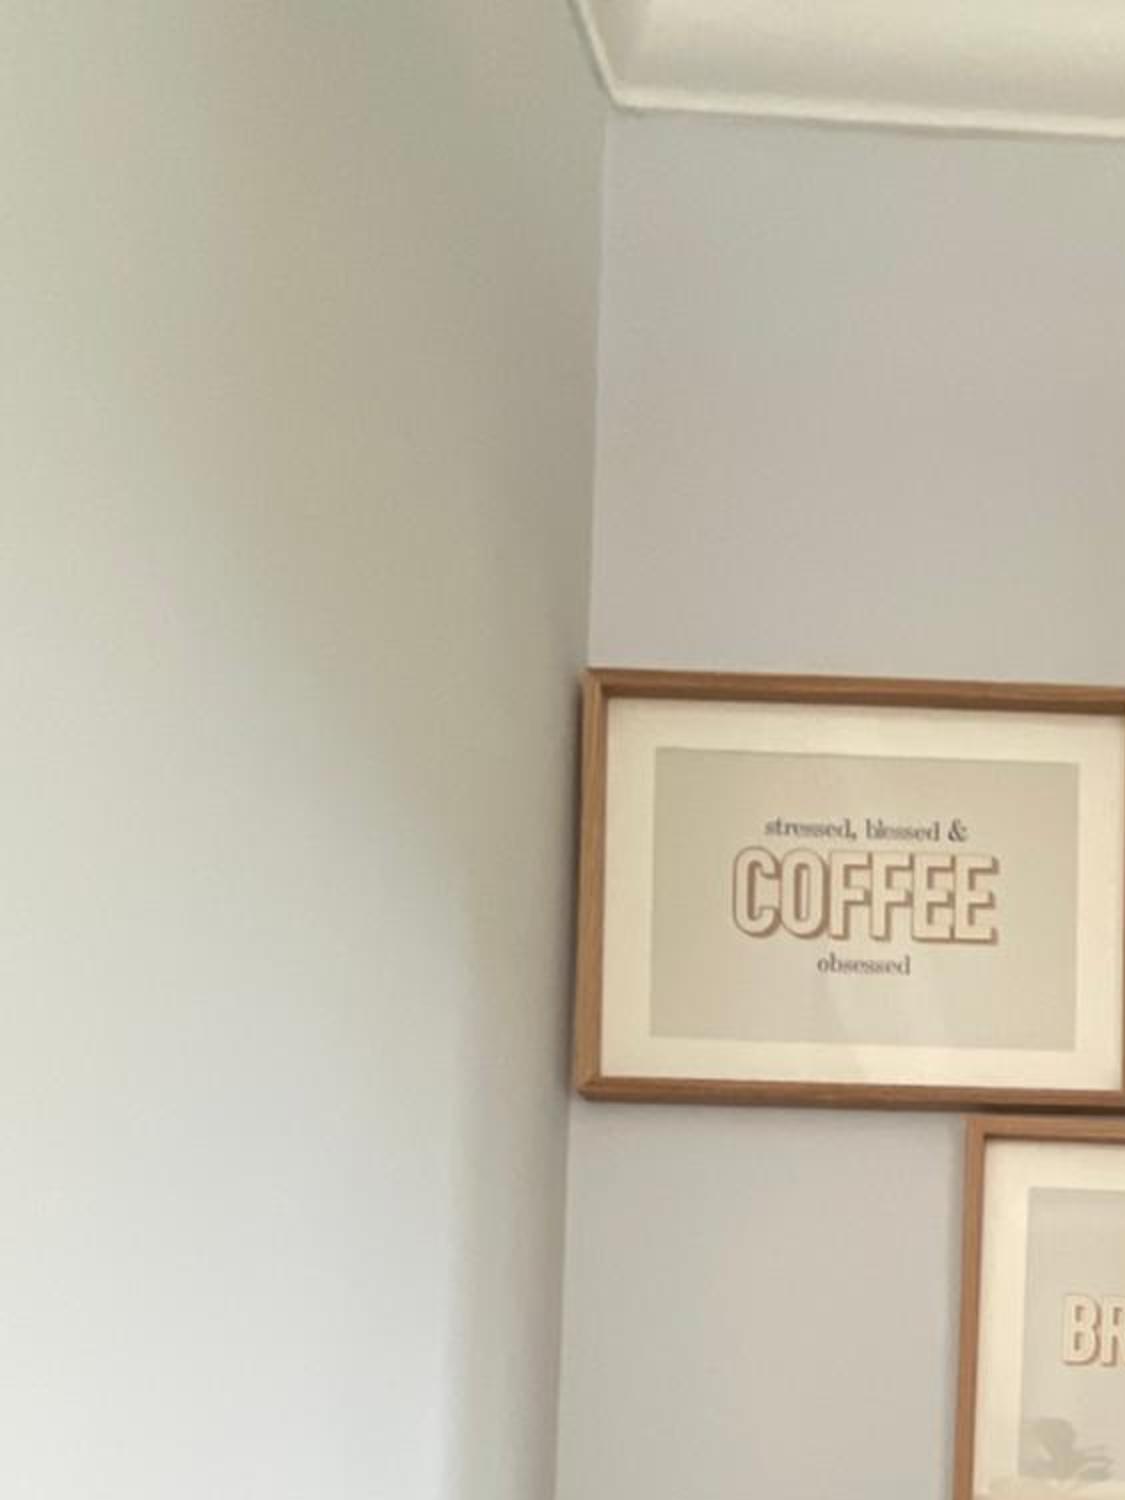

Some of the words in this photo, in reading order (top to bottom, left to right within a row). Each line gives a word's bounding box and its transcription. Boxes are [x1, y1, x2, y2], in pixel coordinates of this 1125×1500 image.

[764, 816, 857, 841] stressed,
[866, 818, 940, 841] blessed
[948, 819, 967, 842] &
[732, 845, 1000, 946] COFFEE
[817, 952, 911, 975] obsessed
